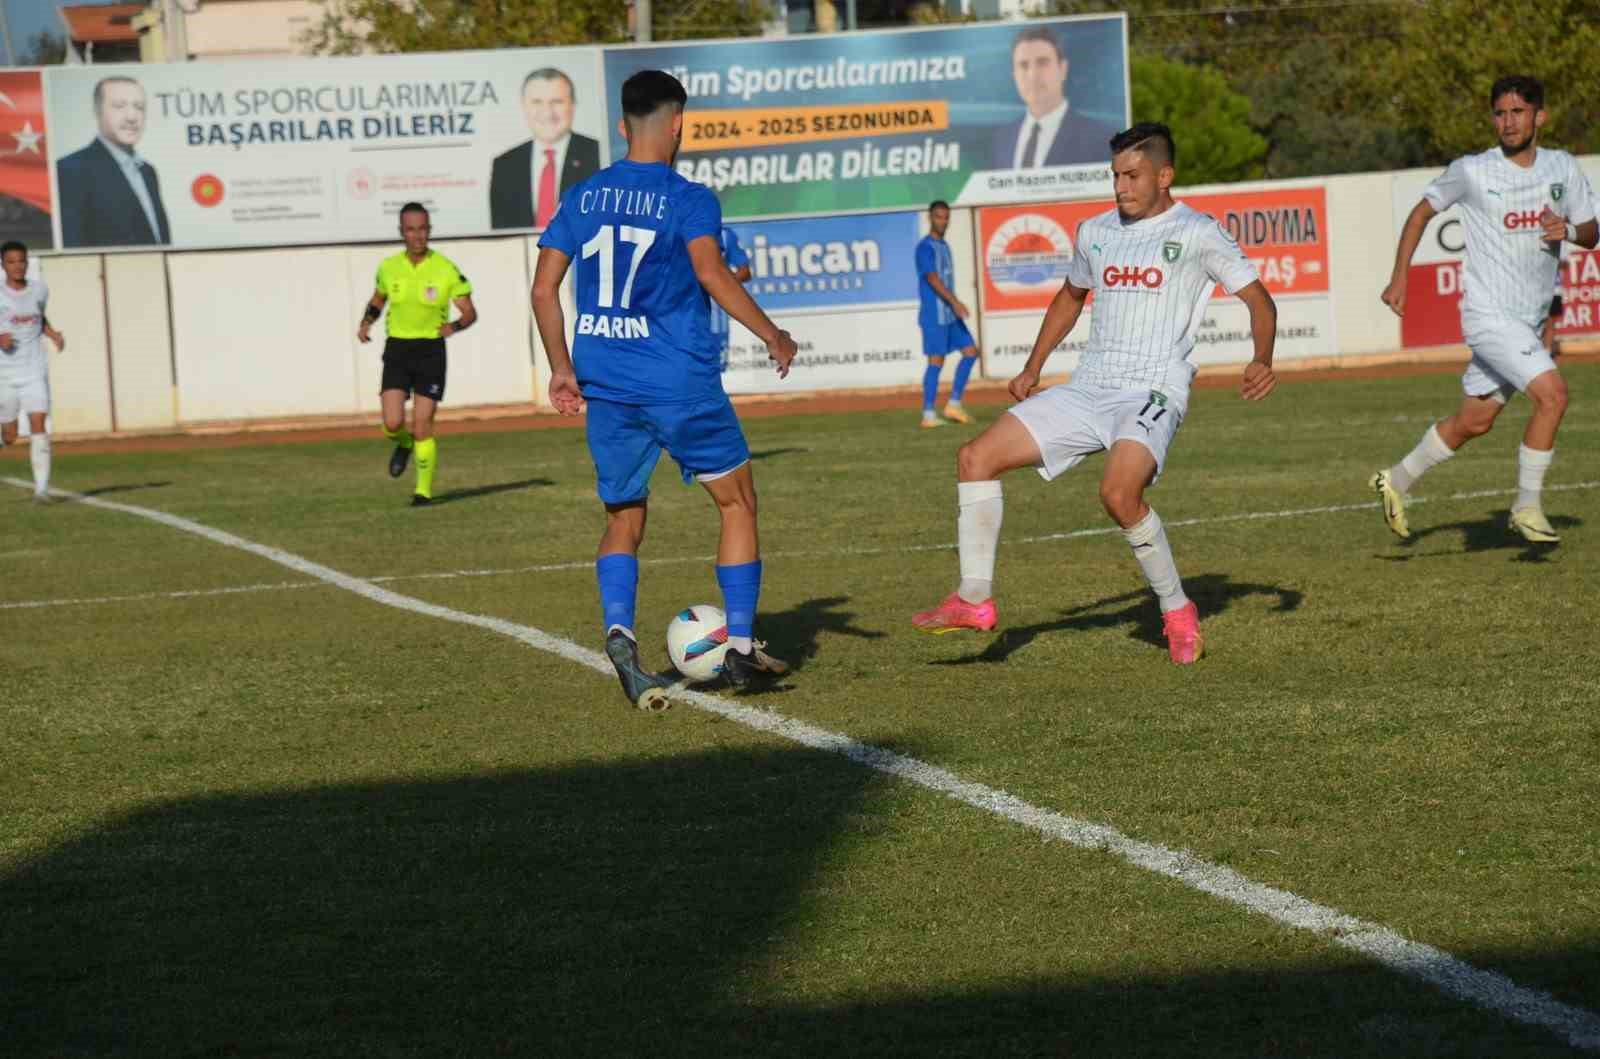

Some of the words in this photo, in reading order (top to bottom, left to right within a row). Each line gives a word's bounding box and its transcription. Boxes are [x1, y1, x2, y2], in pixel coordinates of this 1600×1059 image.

[664, 65, 720, 97] üm
[726, 55, 966, 100] Sporcularımıza
[157, 88, 227, 118] TÜM
[235, 81, 499, 117] SPORCULARIMIZA
[187, 116, 354, 150] BAŞARILAR
[363, 107, 475, 139] DİLERİZ
[692, 120, 741, 139] 2024
[757, 116, 807, 136] 2025
[812, 108, 934, 134] SEZONUNDA
[676, 152, 836, 191] BAŞARILAR
[841, 138, 961, 180] DİLERİM
[1226, 208, 1317, 245] DIDYMA
[582, 224, 656, 309] 17
[746, 235, 880, 279] incan
[577, 313, 650, 339] BARIN
[792, 352, 859, 369] AŞARILAR
